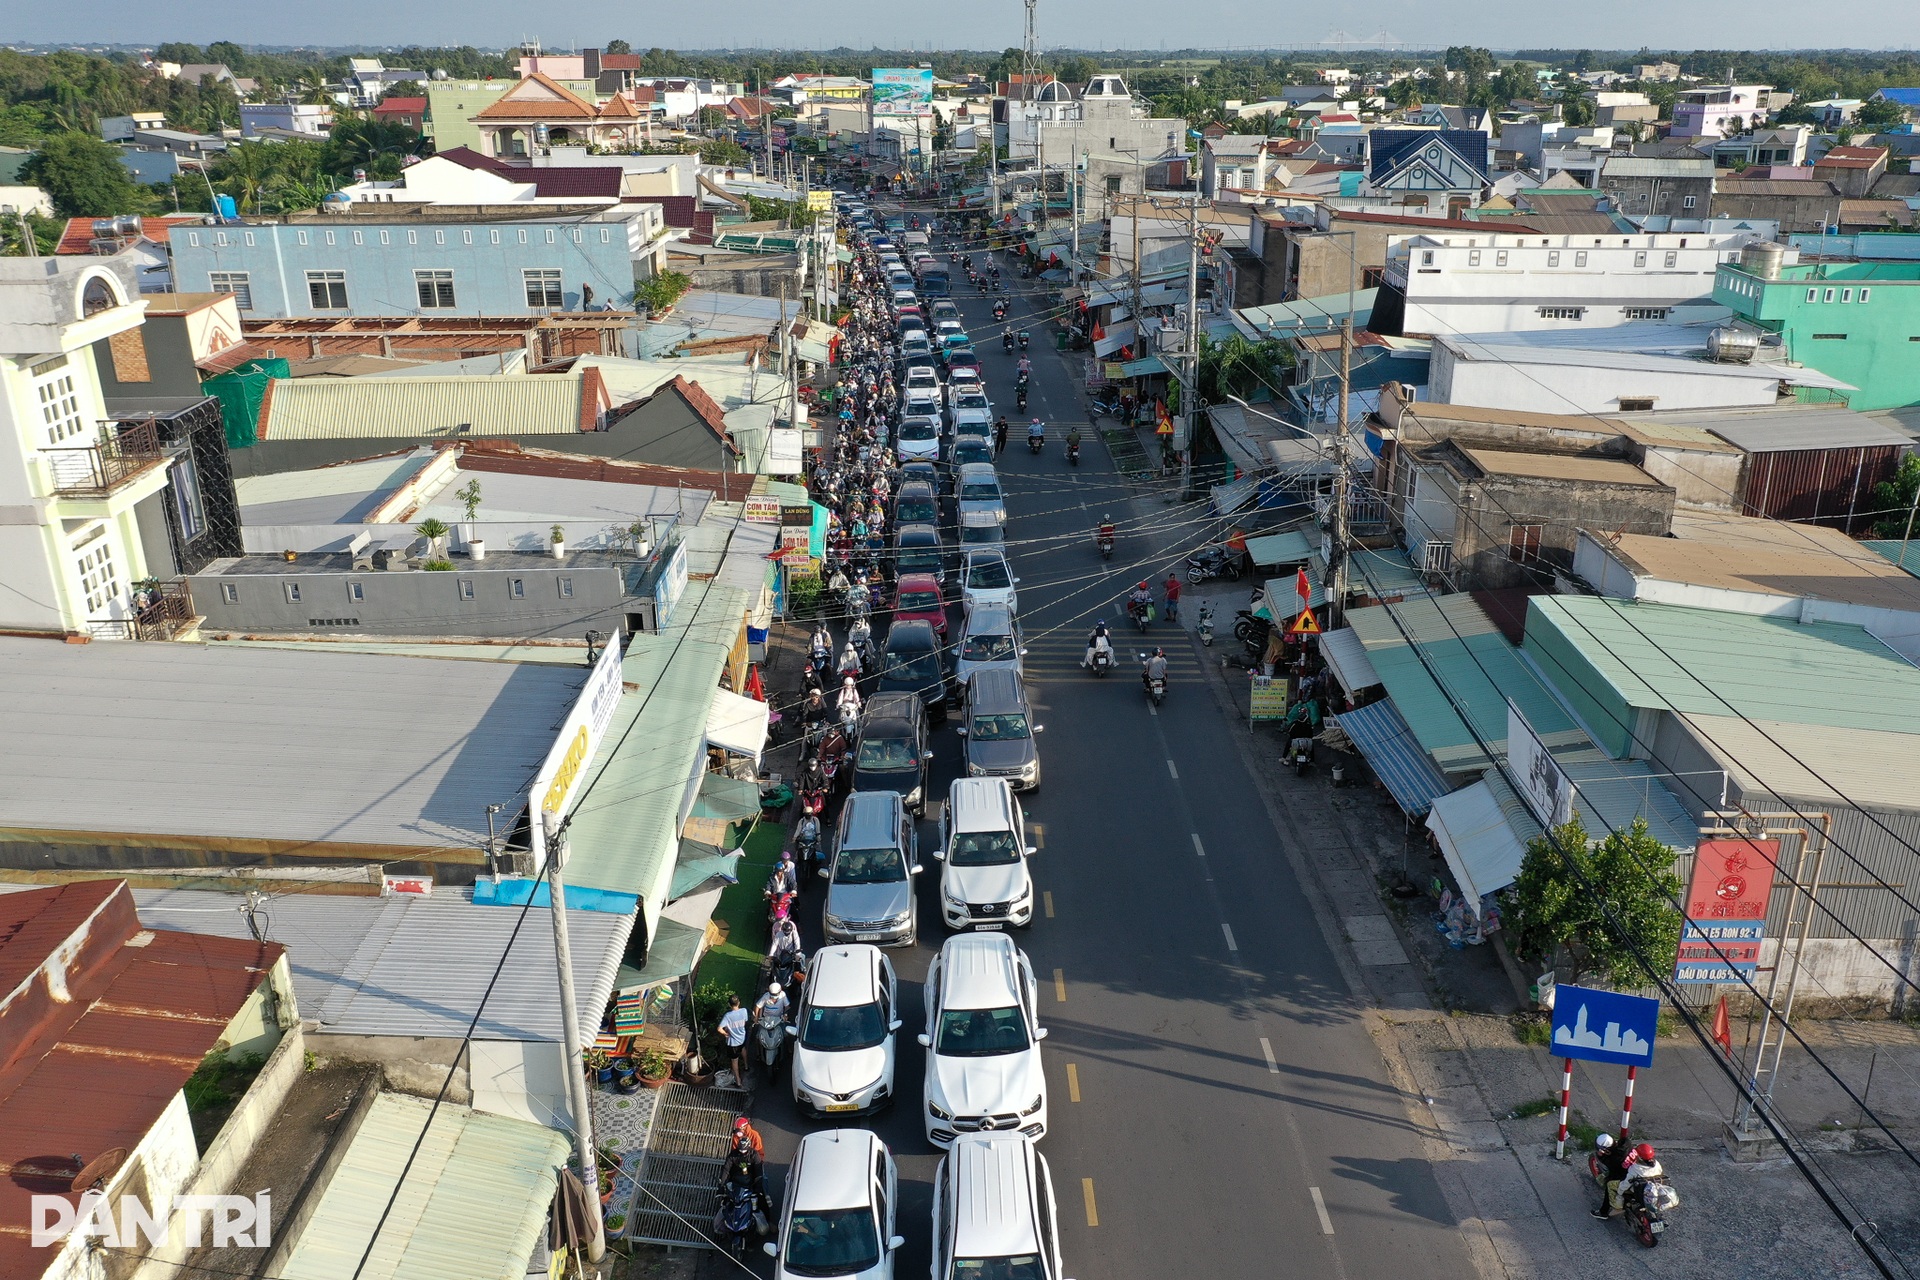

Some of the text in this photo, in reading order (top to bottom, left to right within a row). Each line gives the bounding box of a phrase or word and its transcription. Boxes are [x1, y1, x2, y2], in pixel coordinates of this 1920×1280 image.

[1710, 927, 1721, 938] E5
[1721, 927, 1738, 938] RON
[1739, 927, 1750, 938] 92
[1696, 969, 1708, 979] DO
